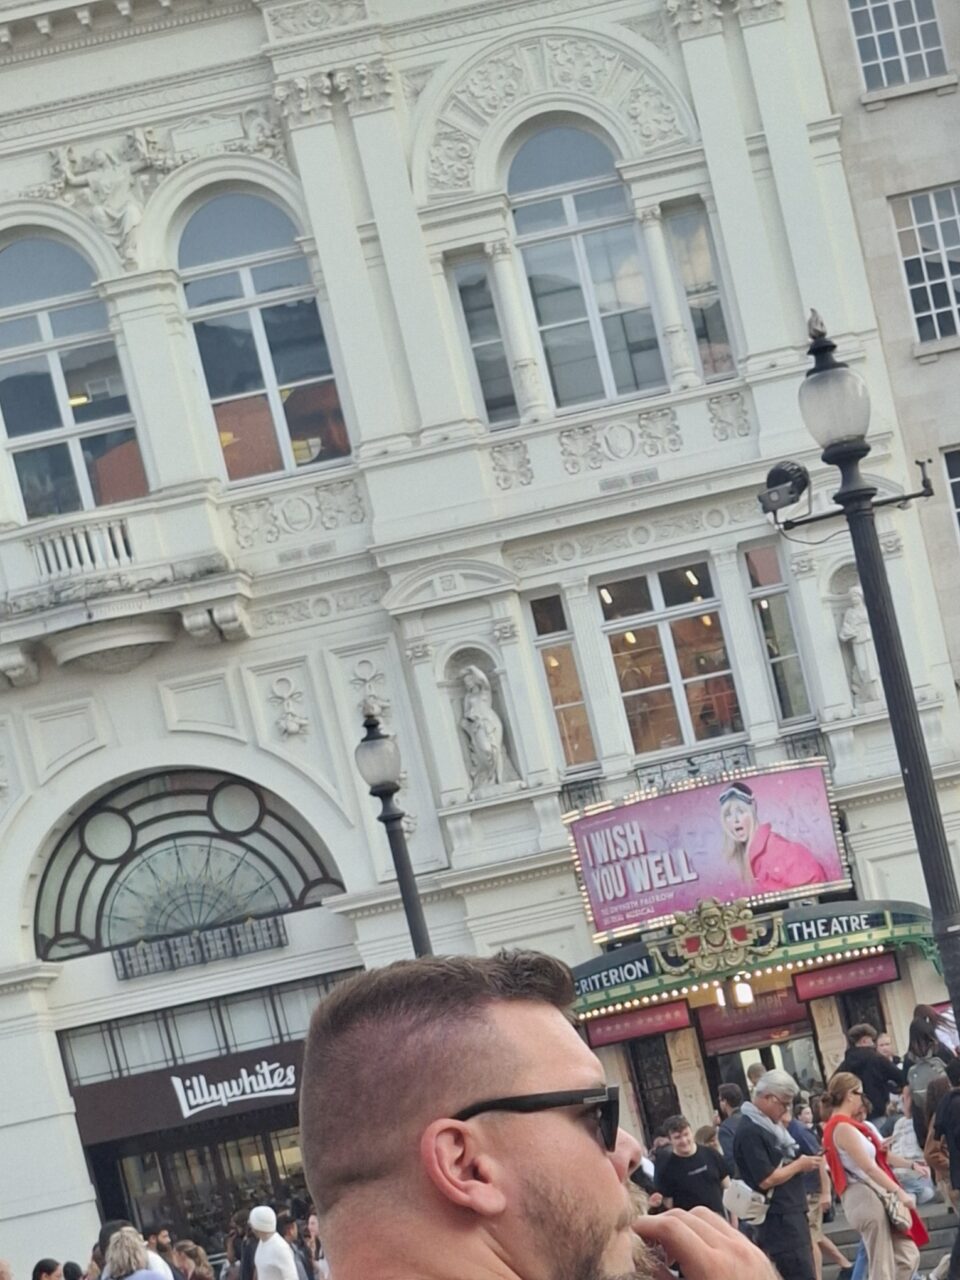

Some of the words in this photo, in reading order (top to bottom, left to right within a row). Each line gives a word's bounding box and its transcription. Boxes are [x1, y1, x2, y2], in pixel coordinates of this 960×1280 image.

[583, 835, 594, 869] I
[590, 820, 646, 866] WISH
[592, 863, 627, 903] YOU
[628, 848, 699, 893] WELL
[574, 958, 649, 995] CRITERION
[787, 914, 870, 941] THEATRE
[171, 1060, 296, 1119] Lillywhites
